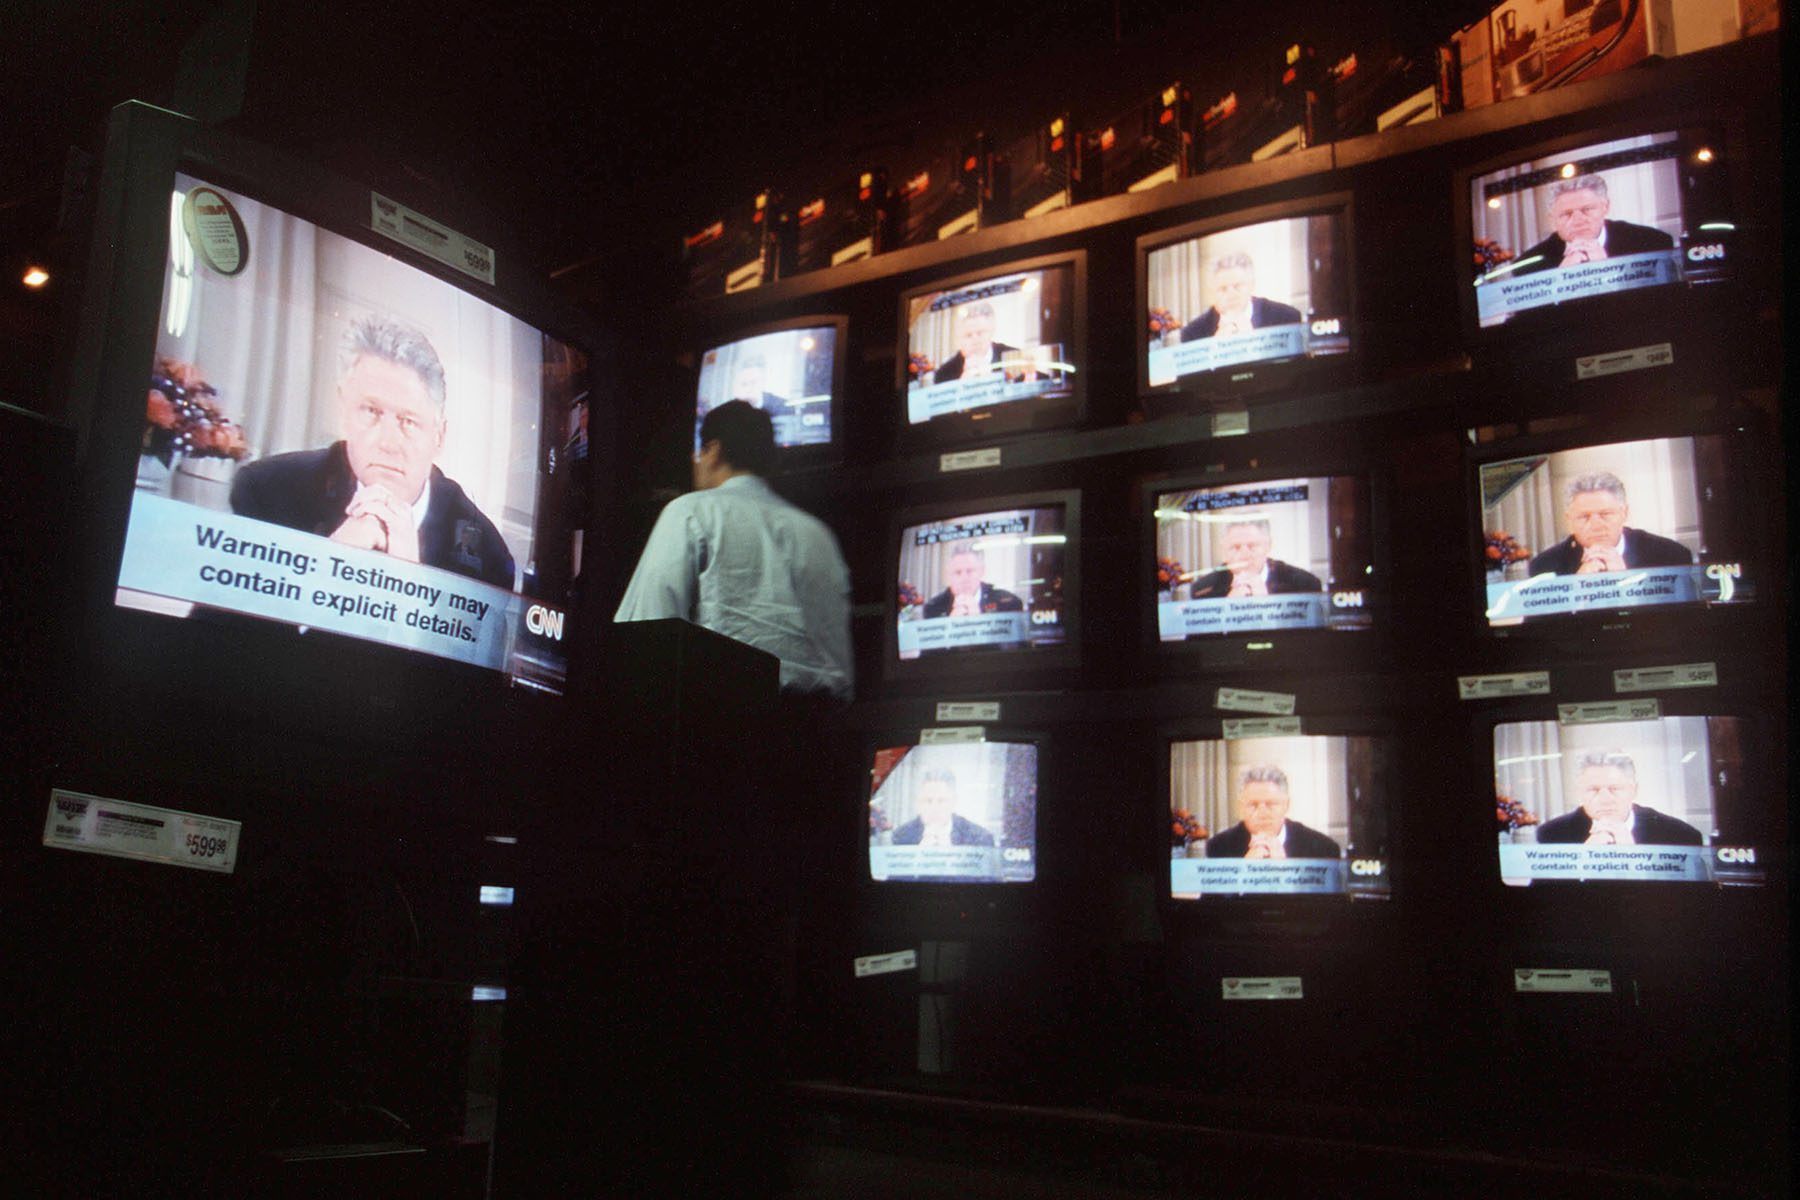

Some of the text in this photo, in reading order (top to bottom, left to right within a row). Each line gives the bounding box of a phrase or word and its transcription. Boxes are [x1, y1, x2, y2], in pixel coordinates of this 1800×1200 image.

[1687, 243, 1725, 262] CNN
[1561, 263, 1626, 283] Testimony
[1630, 257, 1659, 271] may
[1506, 288, 1552, 306] contain
[196, 524, 489, 622] Warning: Testimony may
[1519, 582, 1573, 597] Warning:
[1650, 573, 1679, 585] may
[199, 564, 478, 643] contain explicit details.
[1332, 592, 1363, 608] CNN
[1523, 585, 1676, 609] contain explicit details.
[526, 603, 565, 642] CNN
[1525, 850, 1688, 862] Warning: Testimony may
[1717, 848, 1755, 863] CNN
[1351, 859, 1382, 876] CNN
[1530, 862, 1686, 873] contain explicit details.
